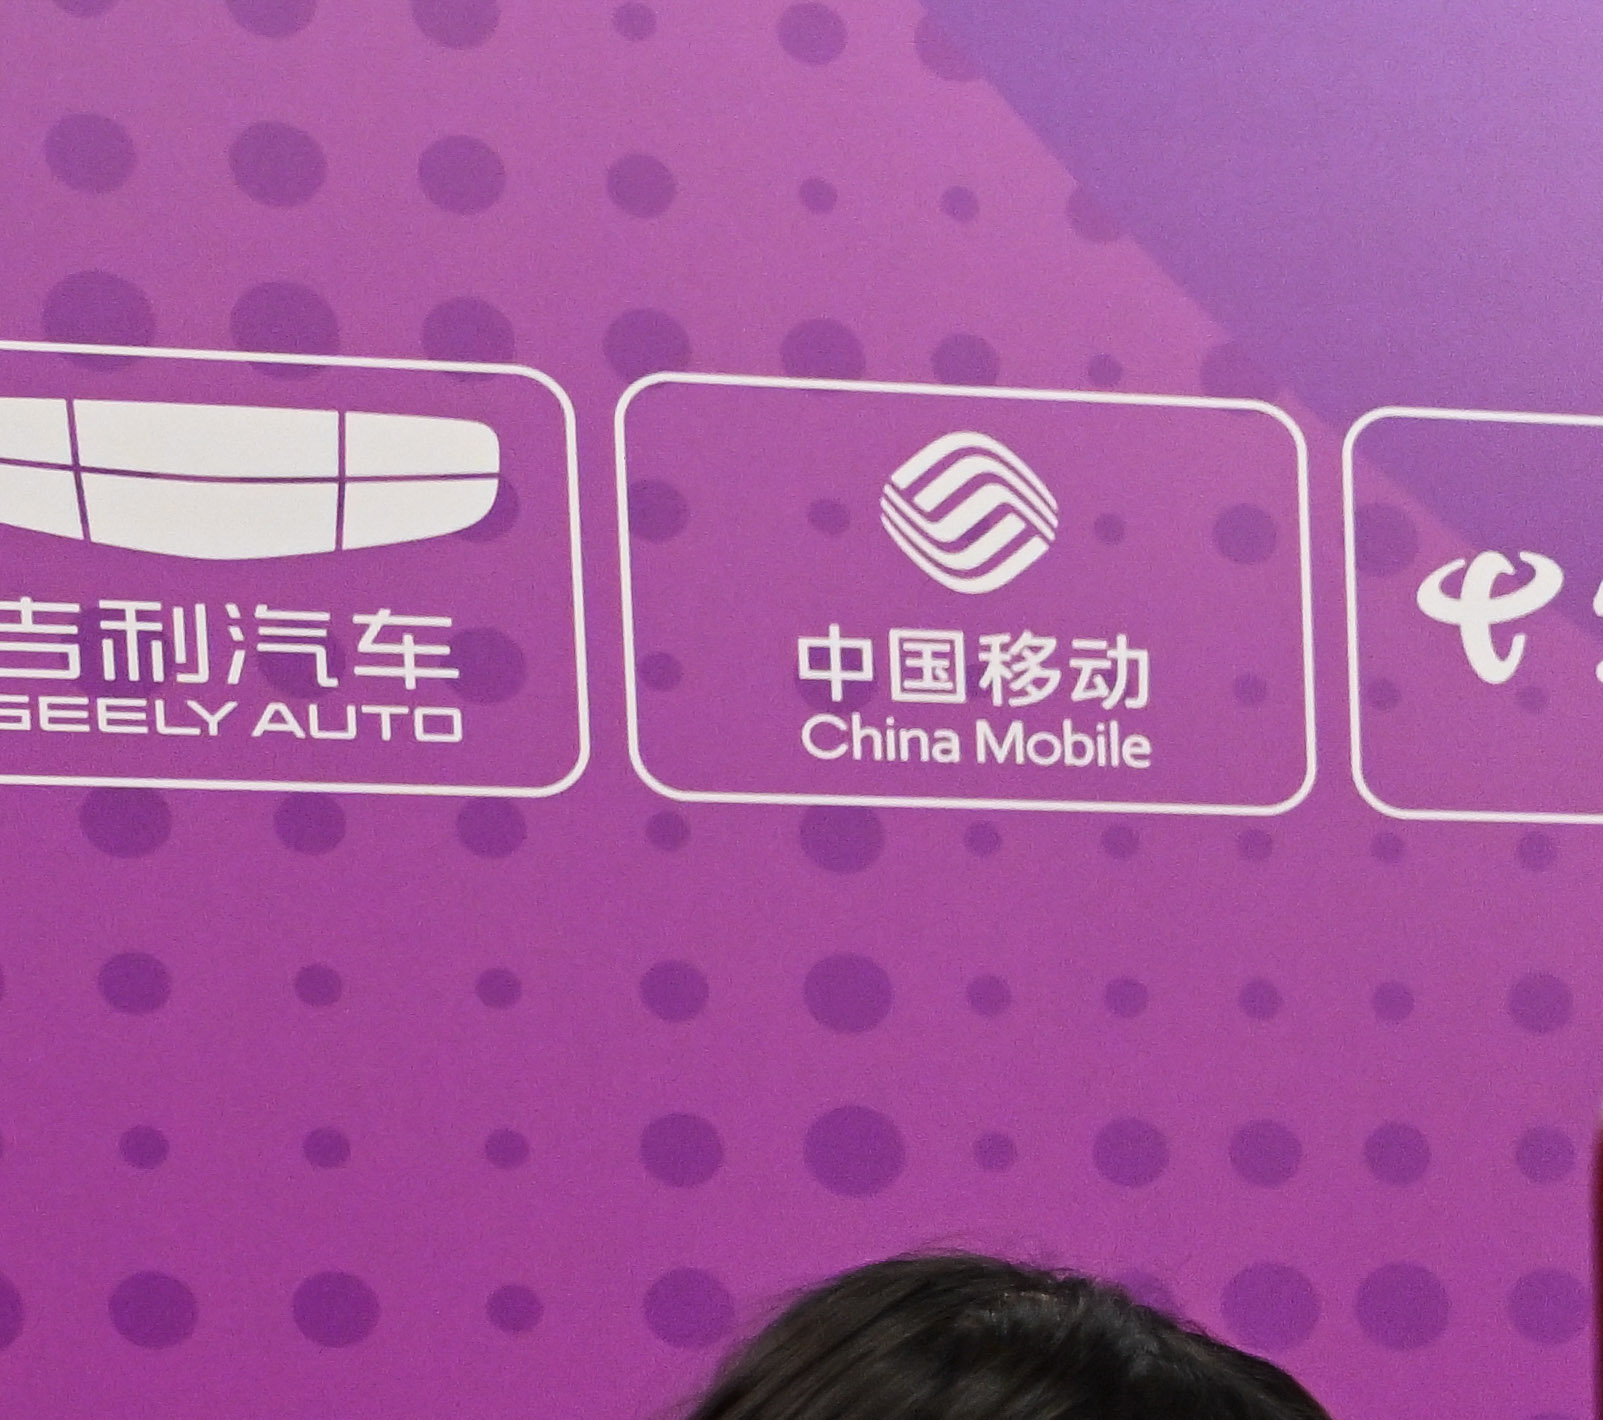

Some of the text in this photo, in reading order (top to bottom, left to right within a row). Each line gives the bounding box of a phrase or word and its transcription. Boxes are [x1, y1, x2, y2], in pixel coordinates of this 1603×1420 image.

[0, 596, 461, 690] 吉利汽车
[797, 622, 1150, 711] 中国移动
[251, 702, 463, 743] AUTO
[801, 711, 1153, 769] China Mobile
